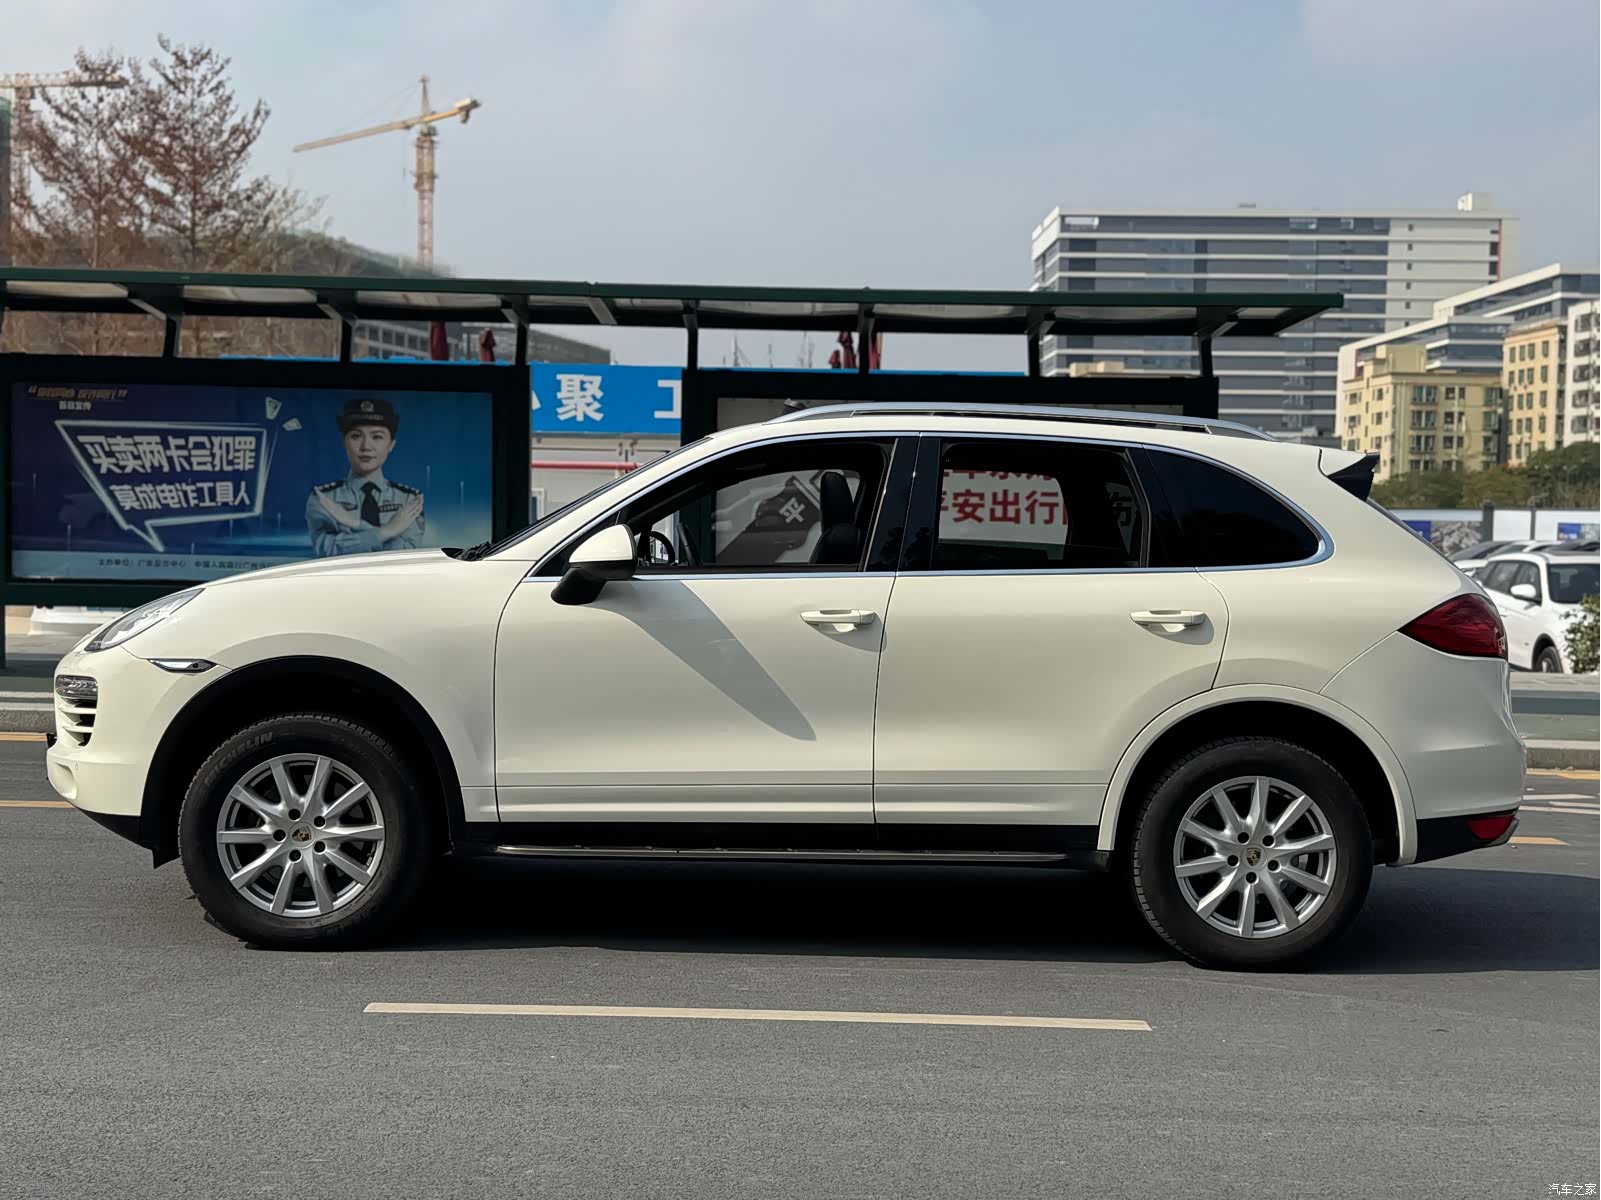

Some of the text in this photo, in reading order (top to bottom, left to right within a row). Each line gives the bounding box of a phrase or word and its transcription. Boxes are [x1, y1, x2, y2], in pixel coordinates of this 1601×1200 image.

[531, 374, 604, 422] 聚
[77, 435, 257, 474] 买卖两卡会犯罪
[109, 481, 251, 511] 莫成电诈工具人
[203, 731, 273, 787] MICHELIN
